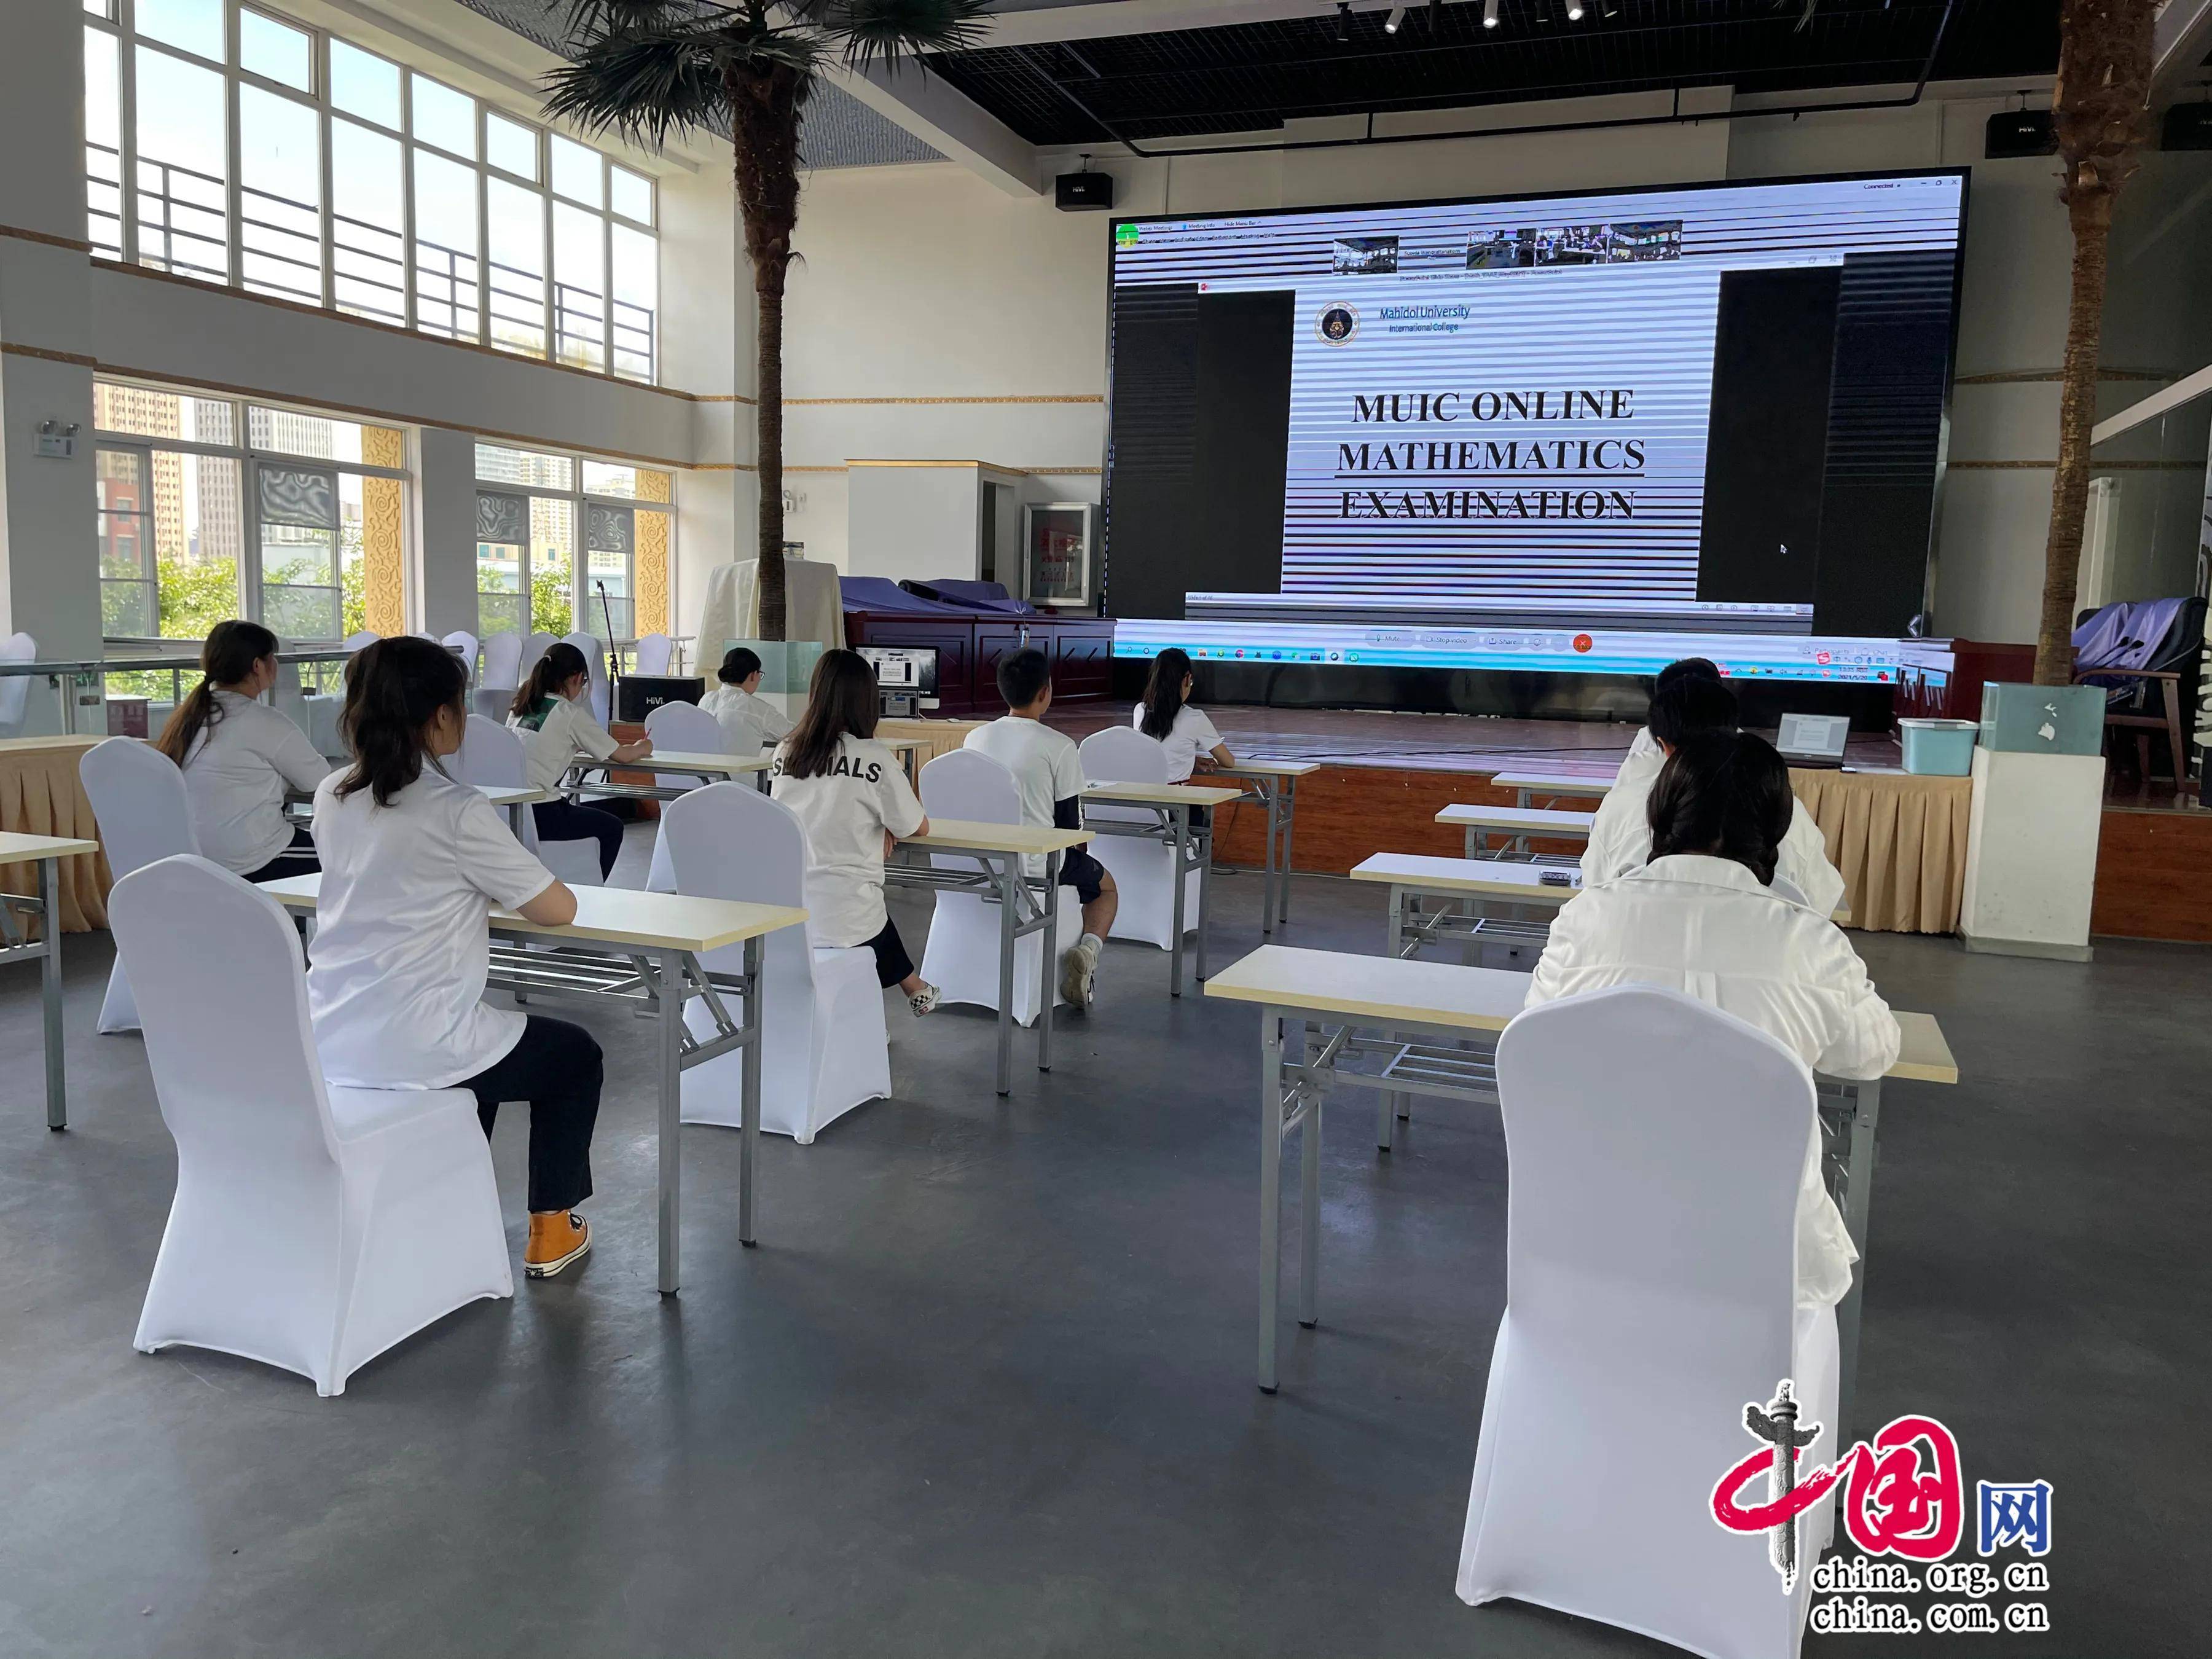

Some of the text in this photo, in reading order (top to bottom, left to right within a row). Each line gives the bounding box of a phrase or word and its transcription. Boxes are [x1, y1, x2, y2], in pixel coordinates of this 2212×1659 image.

[1380, 304, 1470, 320] Mahidol University
[1389, 322, 1459, 333] International College
[1352, 390, 1634, 423] MUIC ONLINE
[1337, 439, 1645, 471] MATHEMATICS
[1338, 490, 1637, 520] EXAMINATION
